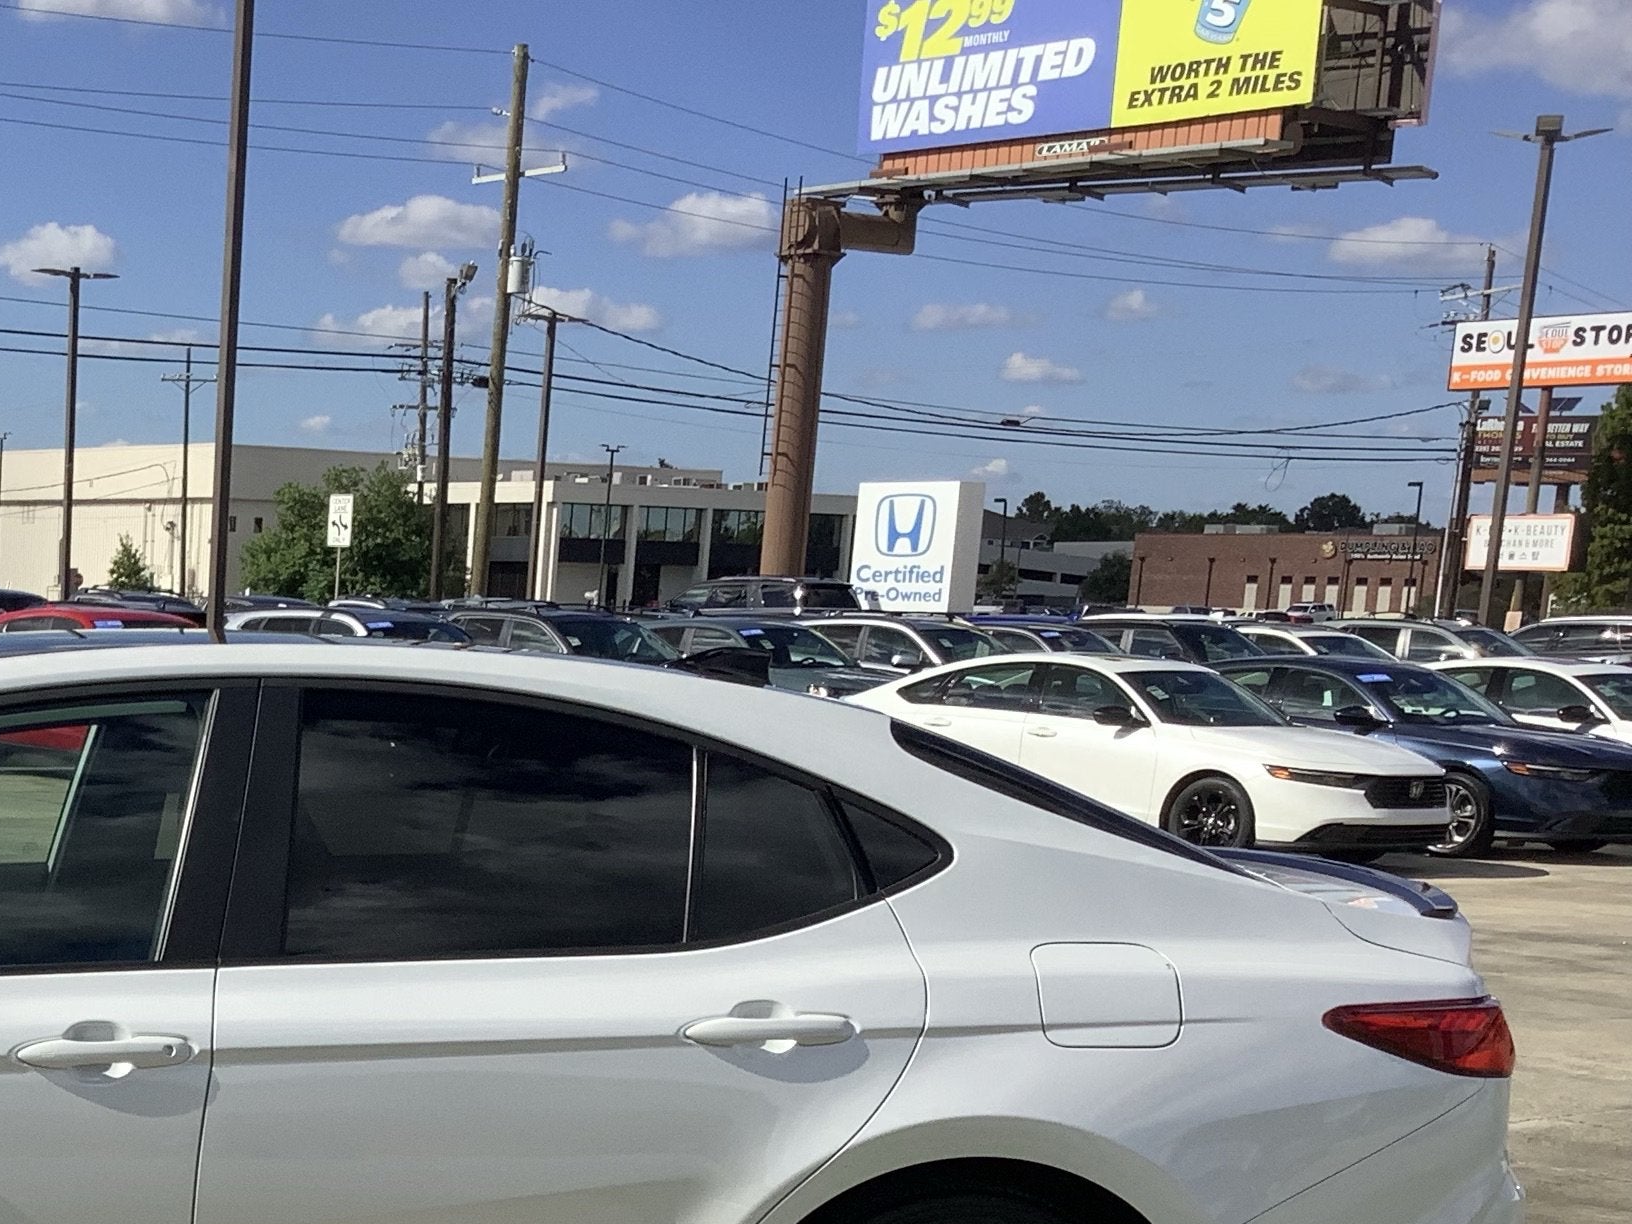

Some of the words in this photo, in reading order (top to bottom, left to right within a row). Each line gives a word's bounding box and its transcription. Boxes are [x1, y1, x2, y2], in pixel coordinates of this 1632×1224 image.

[963, 30, 1010, 48] MONTHLY
[871, 37, 1096, 103] UNLIMITED
[1150, 55, 1232, 85] WORTH
[1239, 50, 1284, 73] THE
[1127, 82, 1199, 110] EXTRA
[1206, 80, 1223, 99] 2
[1228, 71, 1302, 97] MILES
[870, 84, 1038, 141] WASHES
[1452, 369, 1502, 383] K-FOOD
[1596, 362, 1632, 377] STOR
[856, 564, 945, 583] Certified
[854, 586, 943, 603] Pre-Owned
